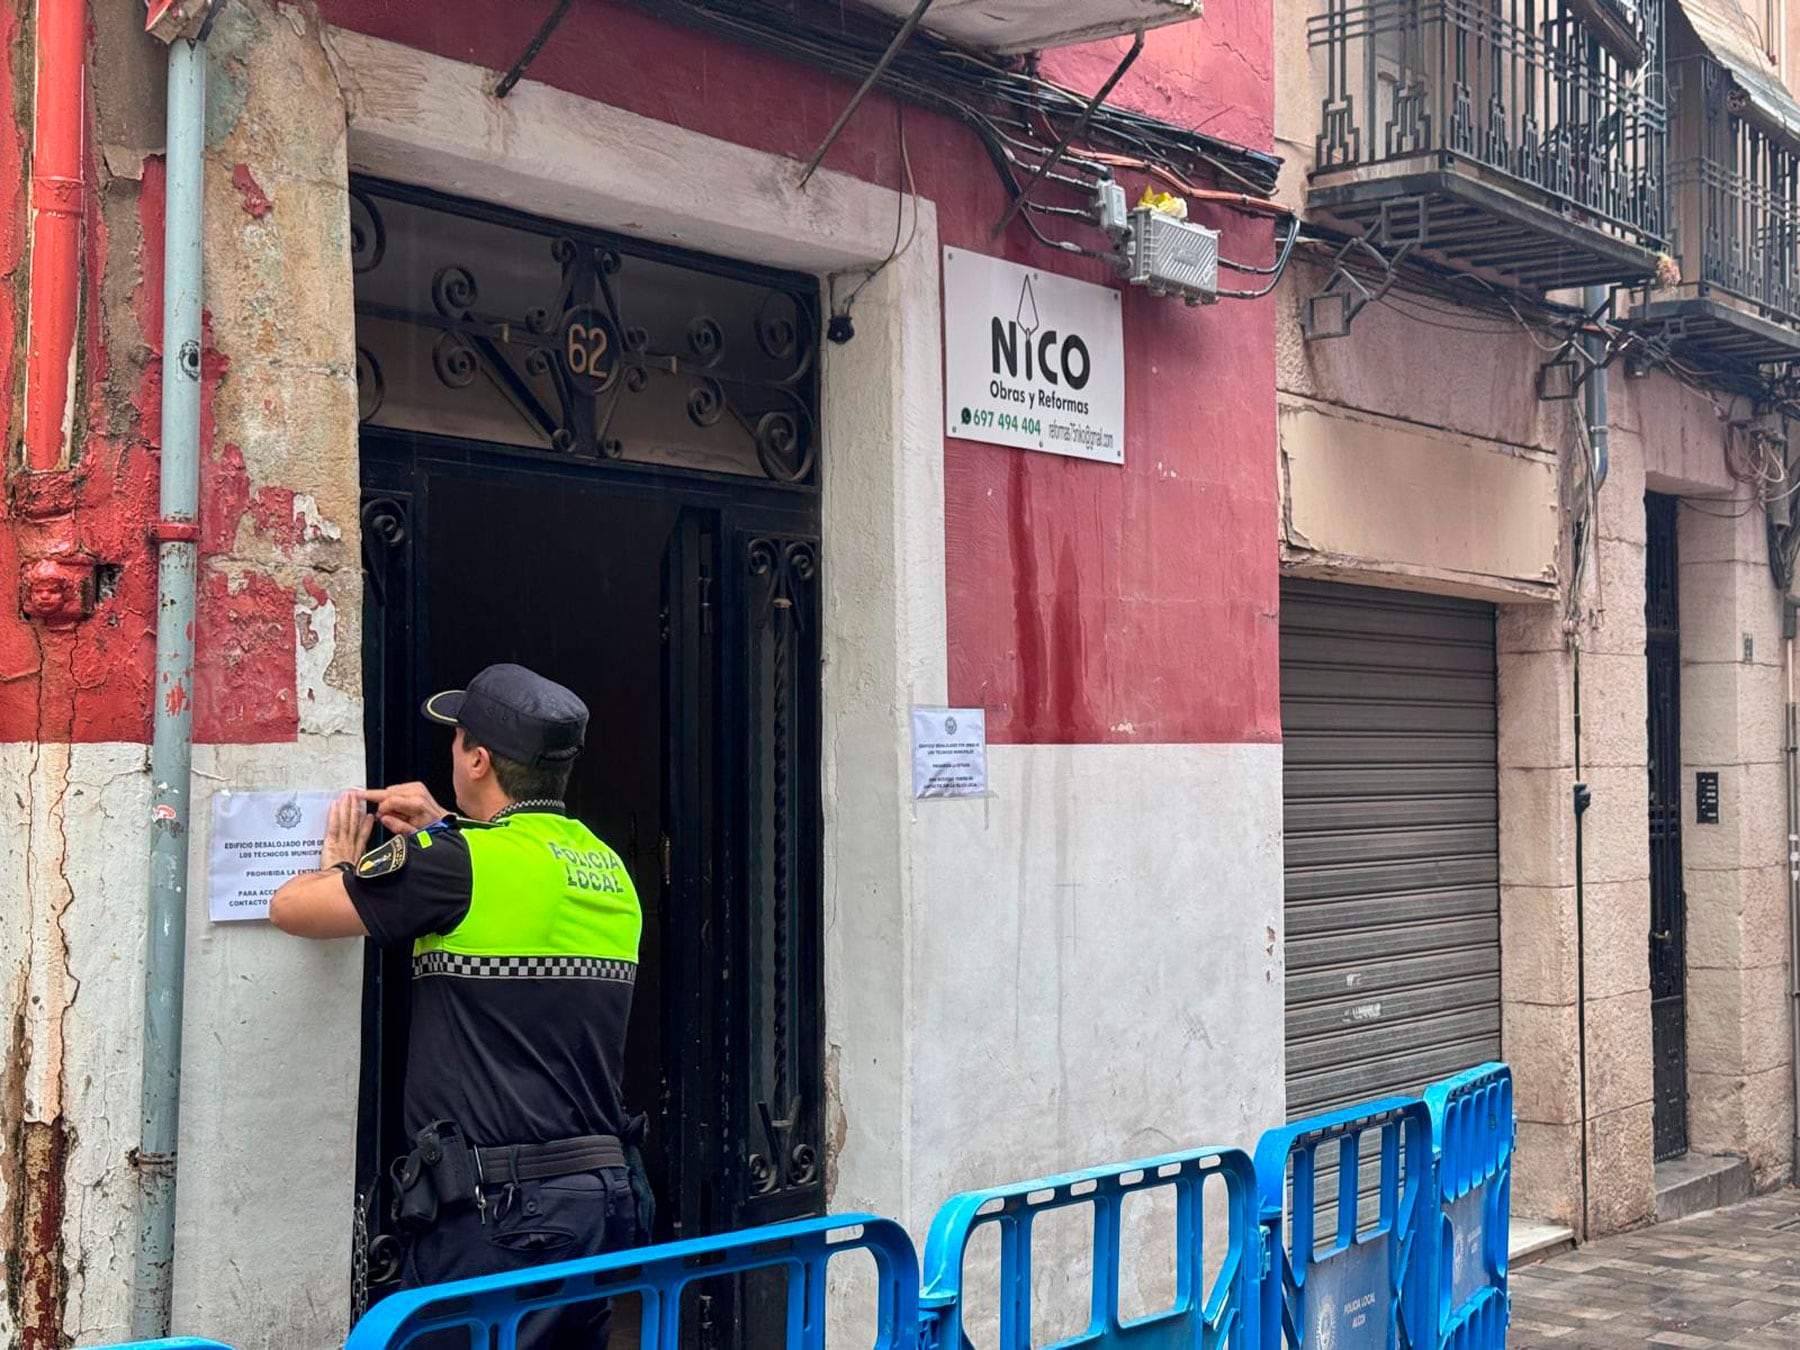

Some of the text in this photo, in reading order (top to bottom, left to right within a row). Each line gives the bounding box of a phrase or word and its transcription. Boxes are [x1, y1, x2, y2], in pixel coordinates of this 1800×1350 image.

[569, 323, 607, 378] 62
[990, 380, 1090, 415] Obras y Reformas
[973, 408, 995, 428] 697
[998, 413, 1019, 433] 494
[1021, 418, 1042, 437] 404
[254, 840, 301, 848] DESALOJADO
[565, 864, 624, 893] LOCAL
